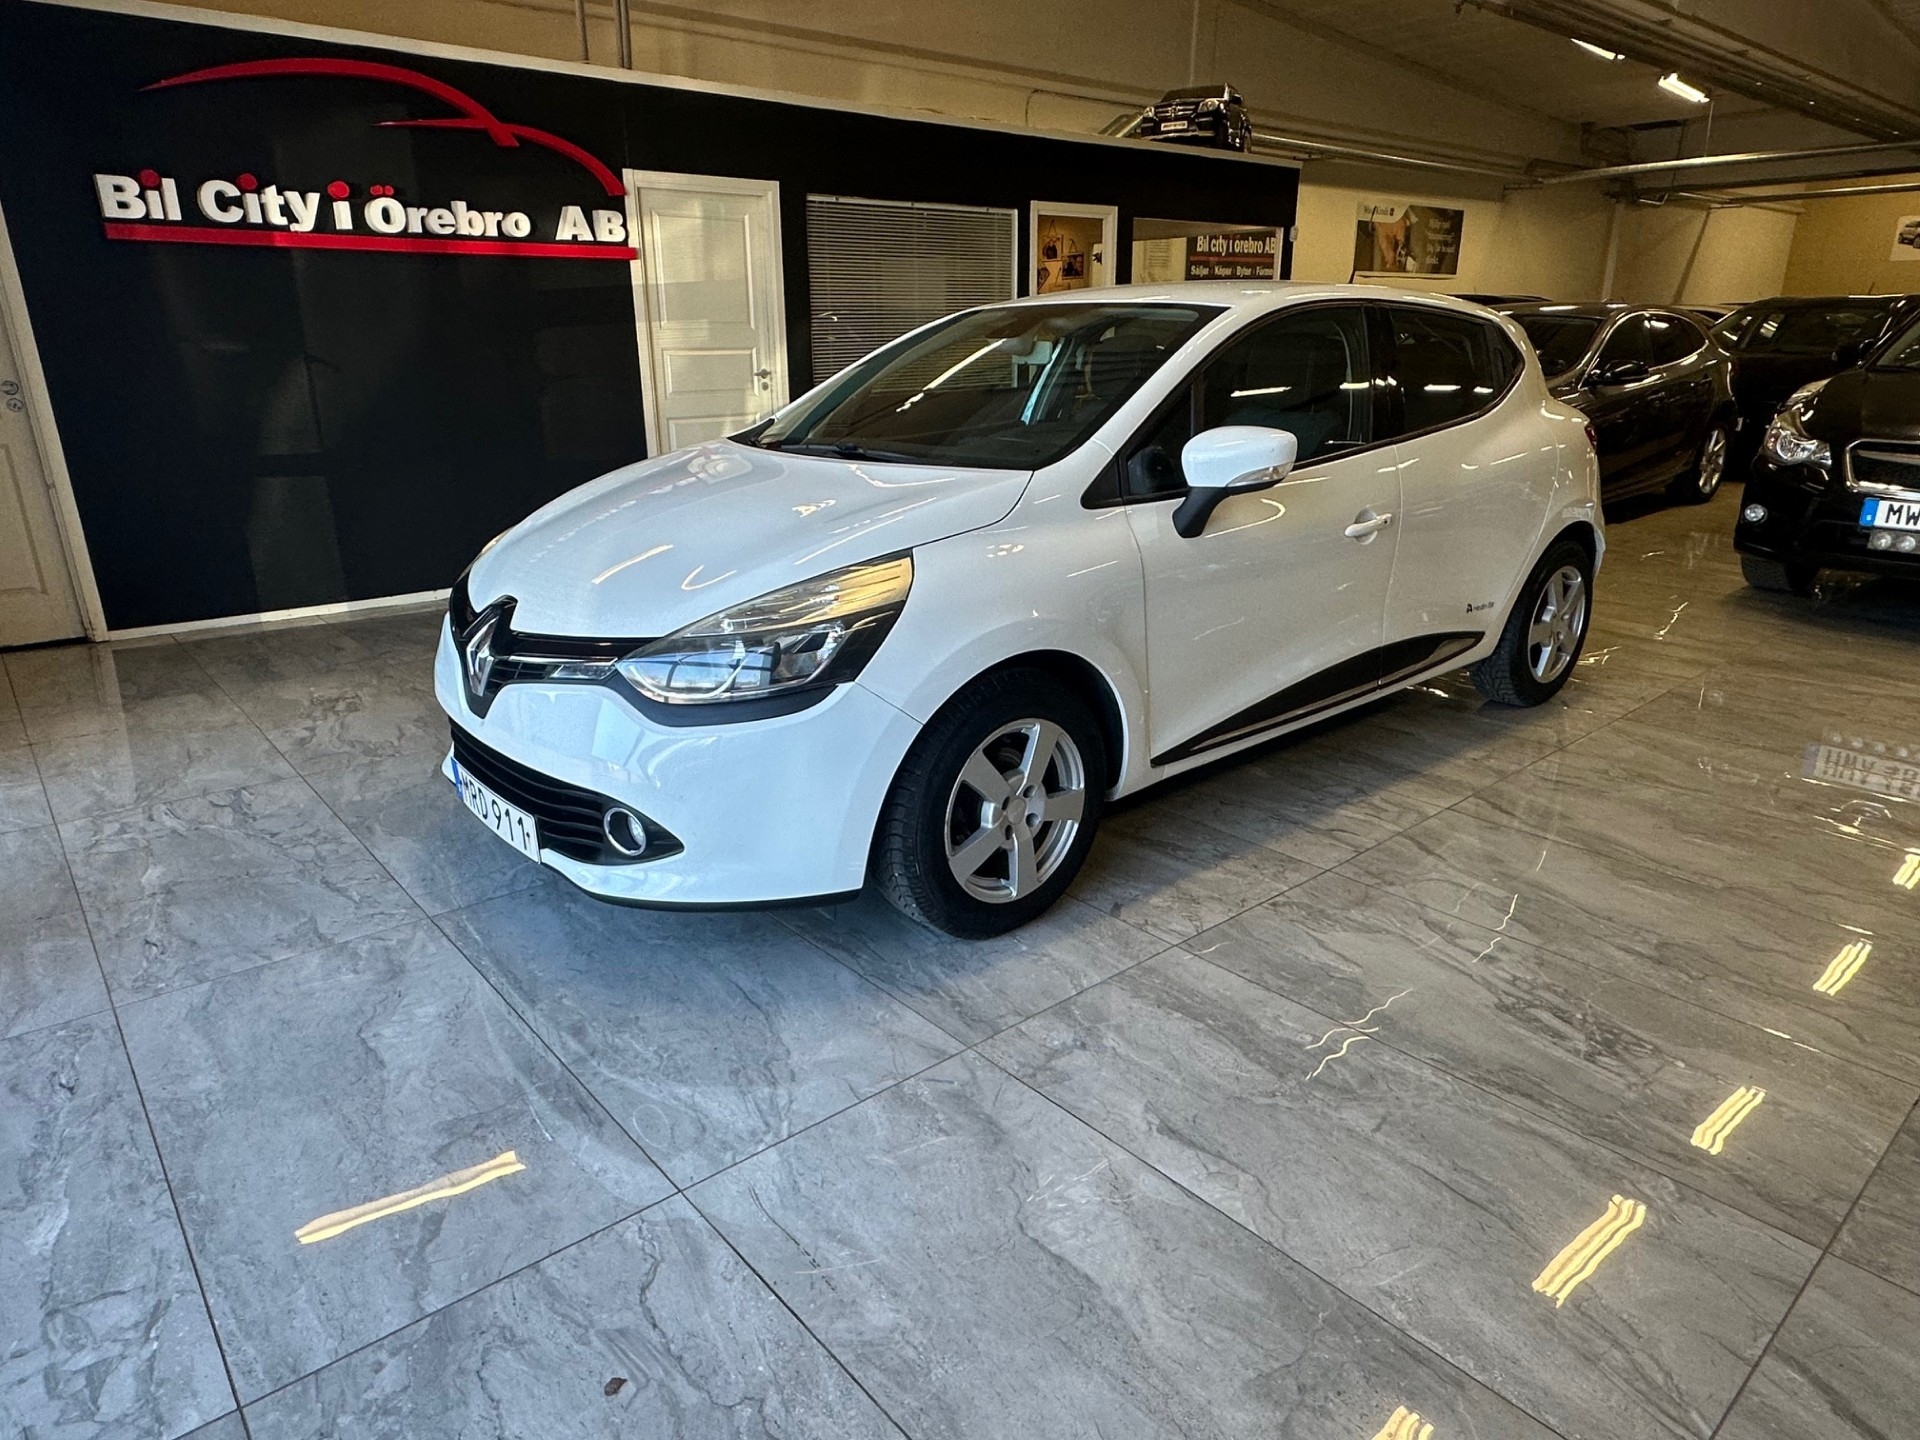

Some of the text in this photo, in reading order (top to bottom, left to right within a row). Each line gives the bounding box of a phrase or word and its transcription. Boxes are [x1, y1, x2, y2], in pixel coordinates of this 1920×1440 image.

[93, 169, 626, 242] Bil City i Örebro AB
[1196, 235, 1209, 252] Bil
[461, 770, 527, 850] MRD 911
